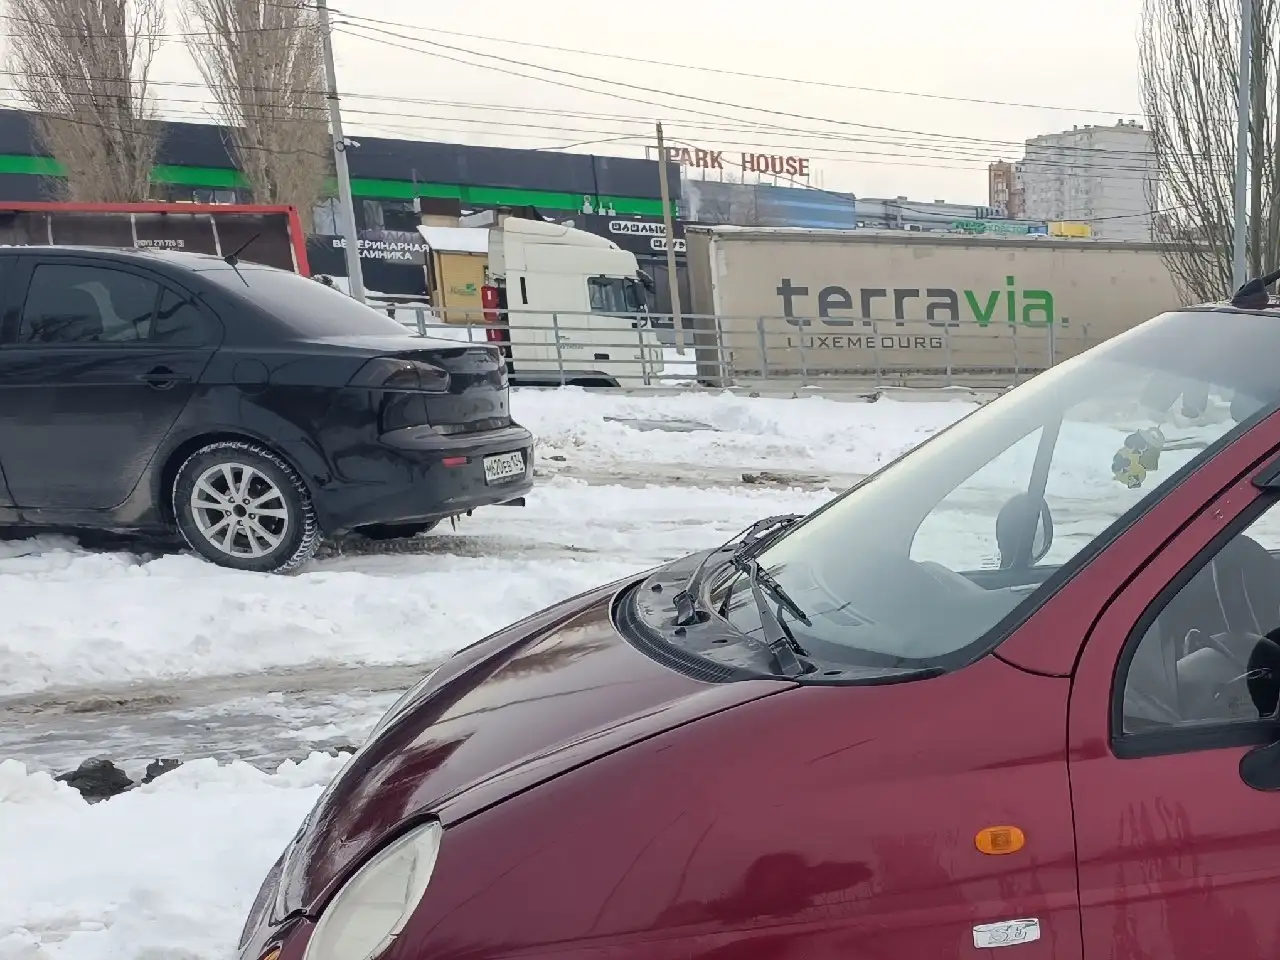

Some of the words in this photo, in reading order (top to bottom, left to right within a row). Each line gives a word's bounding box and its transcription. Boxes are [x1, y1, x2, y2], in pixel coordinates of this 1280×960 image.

[666, 147, 723, 170] PARK
[741, 152, 810, 177] HOUSE
[332, 239, 430, 253] ВЕЕРИНАРНАЯ
